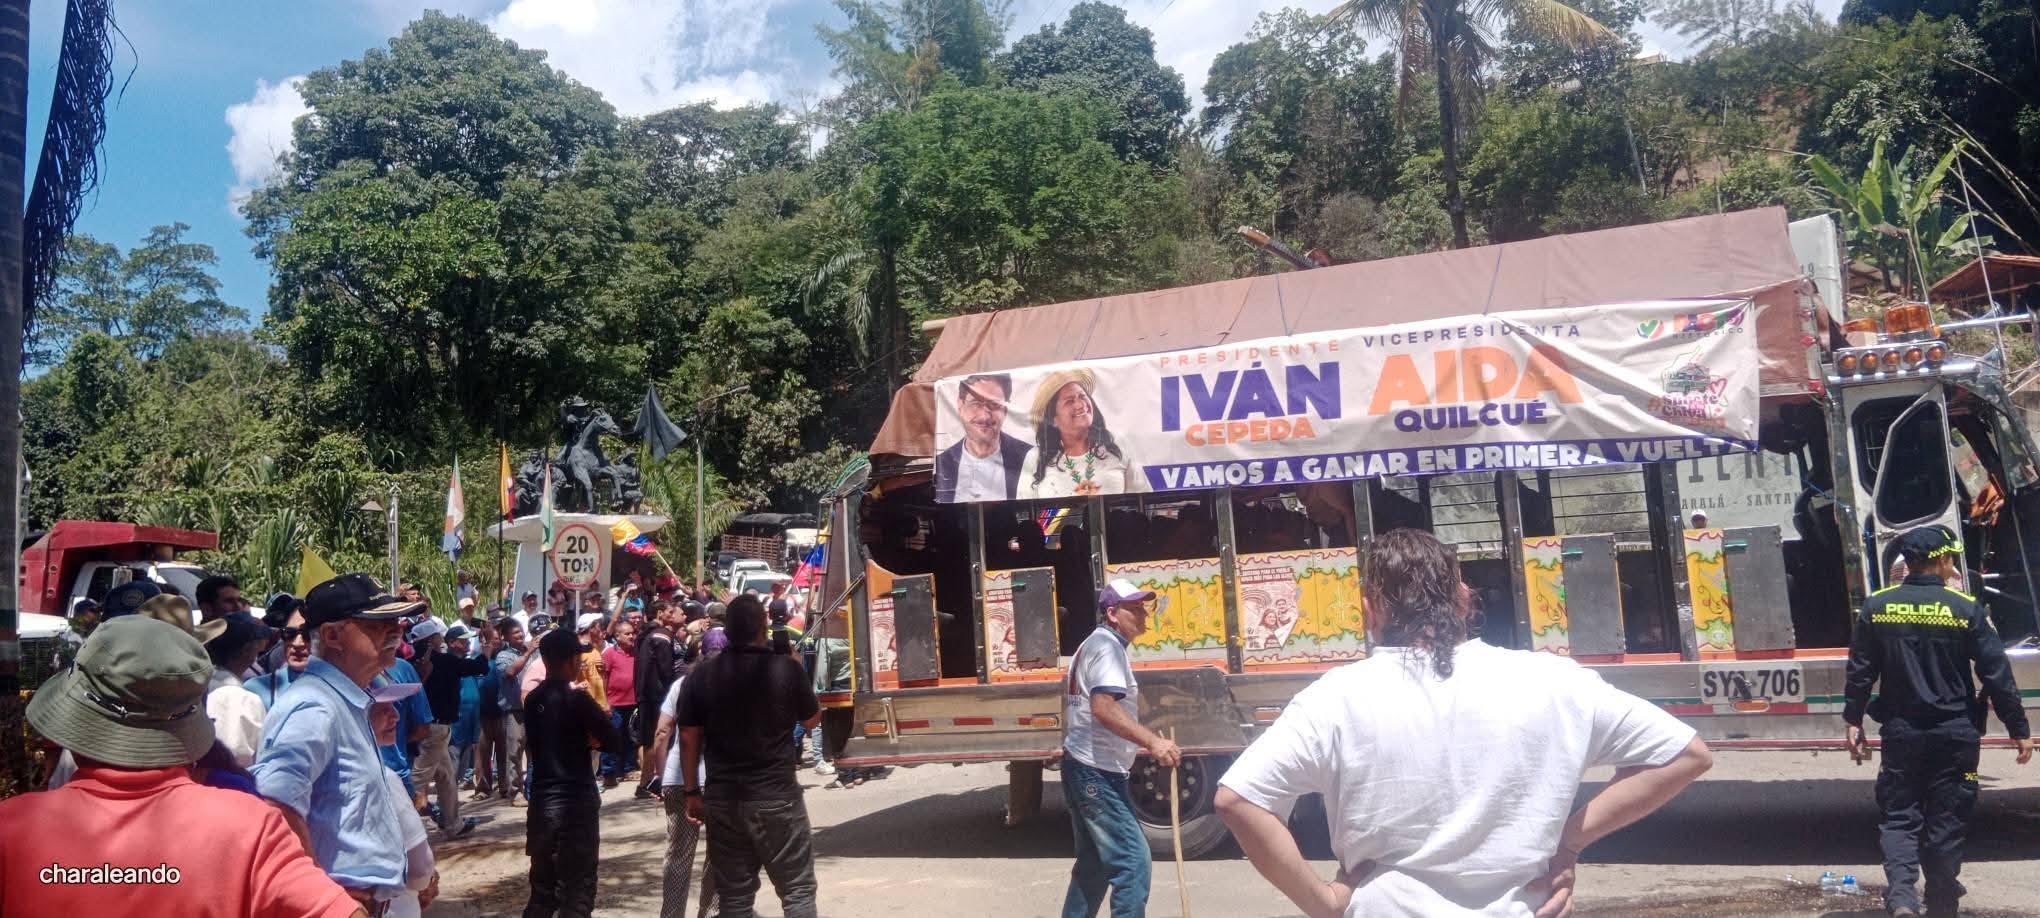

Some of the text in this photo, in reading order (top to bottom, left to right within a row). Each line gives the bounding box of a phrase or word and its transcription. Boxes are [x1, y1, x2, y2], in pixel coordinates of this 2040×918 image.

[1363, 324, 1581, 348] VICEPRESIDENTA
[1159, 339, 1340, 369] PRESIDENTE
[1367, 345, 1585, 416] AIDA
[1160, 361, 1342, 432] IVÁN
[1394, 398, 1548, 433] QUILCUÉ
[1185, 417, 1316, 447] CEPEDA
[1160, 461, 1265, 488] VAMOS
[1272, 459, 1295, 483] A
[1302, 451, 1408, 481] GANAR
[1417, 447, 1457, 472] EN
[1464, 441, 1608, 470] PRIMERA
[1681, 493, 1726, 510] ARALÁ
[566, 535, 589, 554] 20
[560, 557, 594, 573] TON
[1885, 601, 1953, 618] POLICÍA
[1757, 669, 1801, 697] 706
